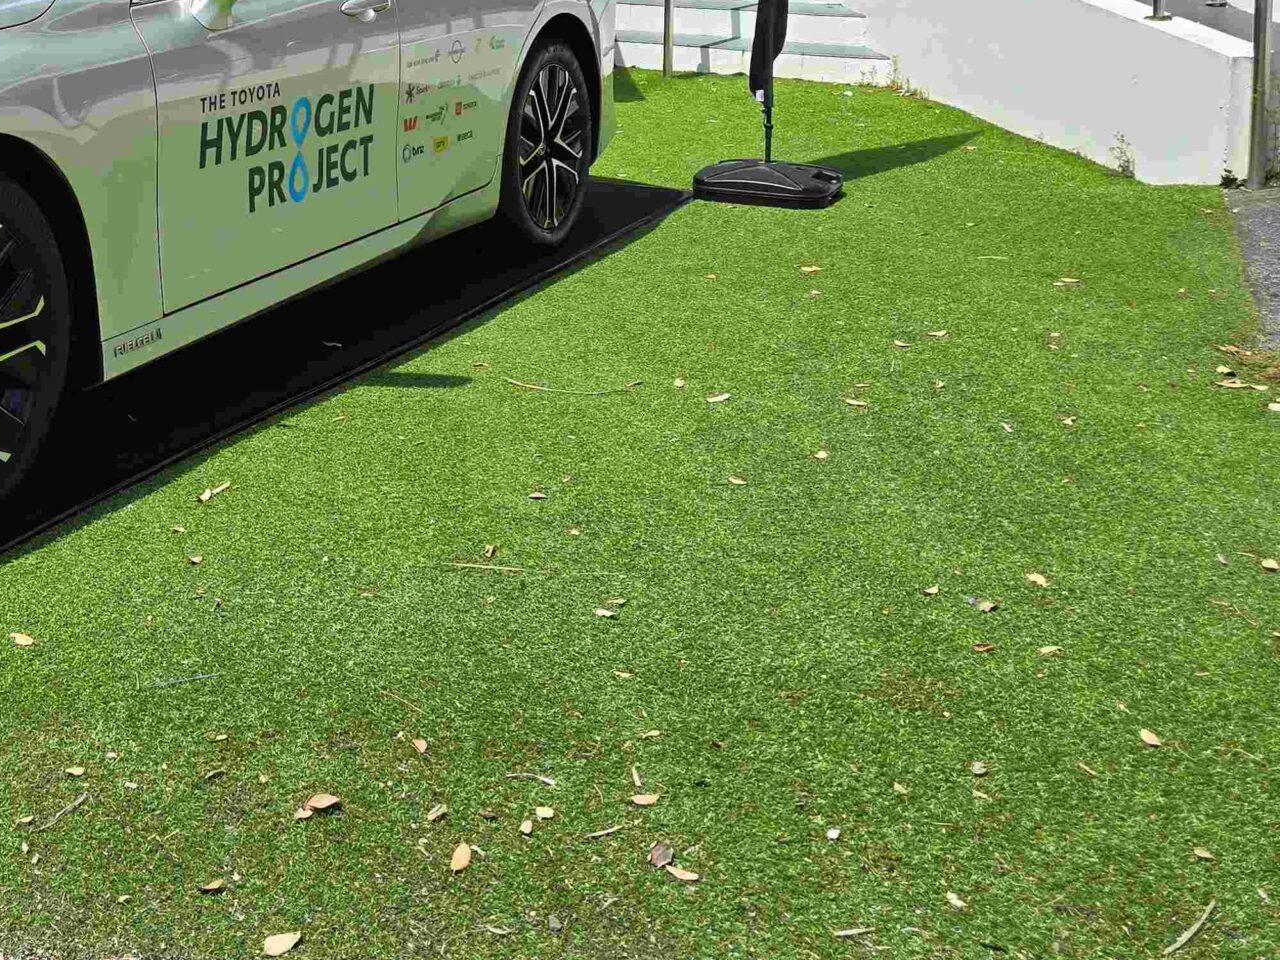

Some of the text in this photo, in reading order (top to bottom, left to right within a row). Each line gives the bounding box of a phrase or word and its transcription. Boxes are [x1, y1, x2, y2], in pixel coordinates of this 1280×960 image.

[199, 84, 375, 169] HYDROGEN
[200, 82, 281, 113] THE TOYOTA
[248, 134, 374, 213] PROJECT
